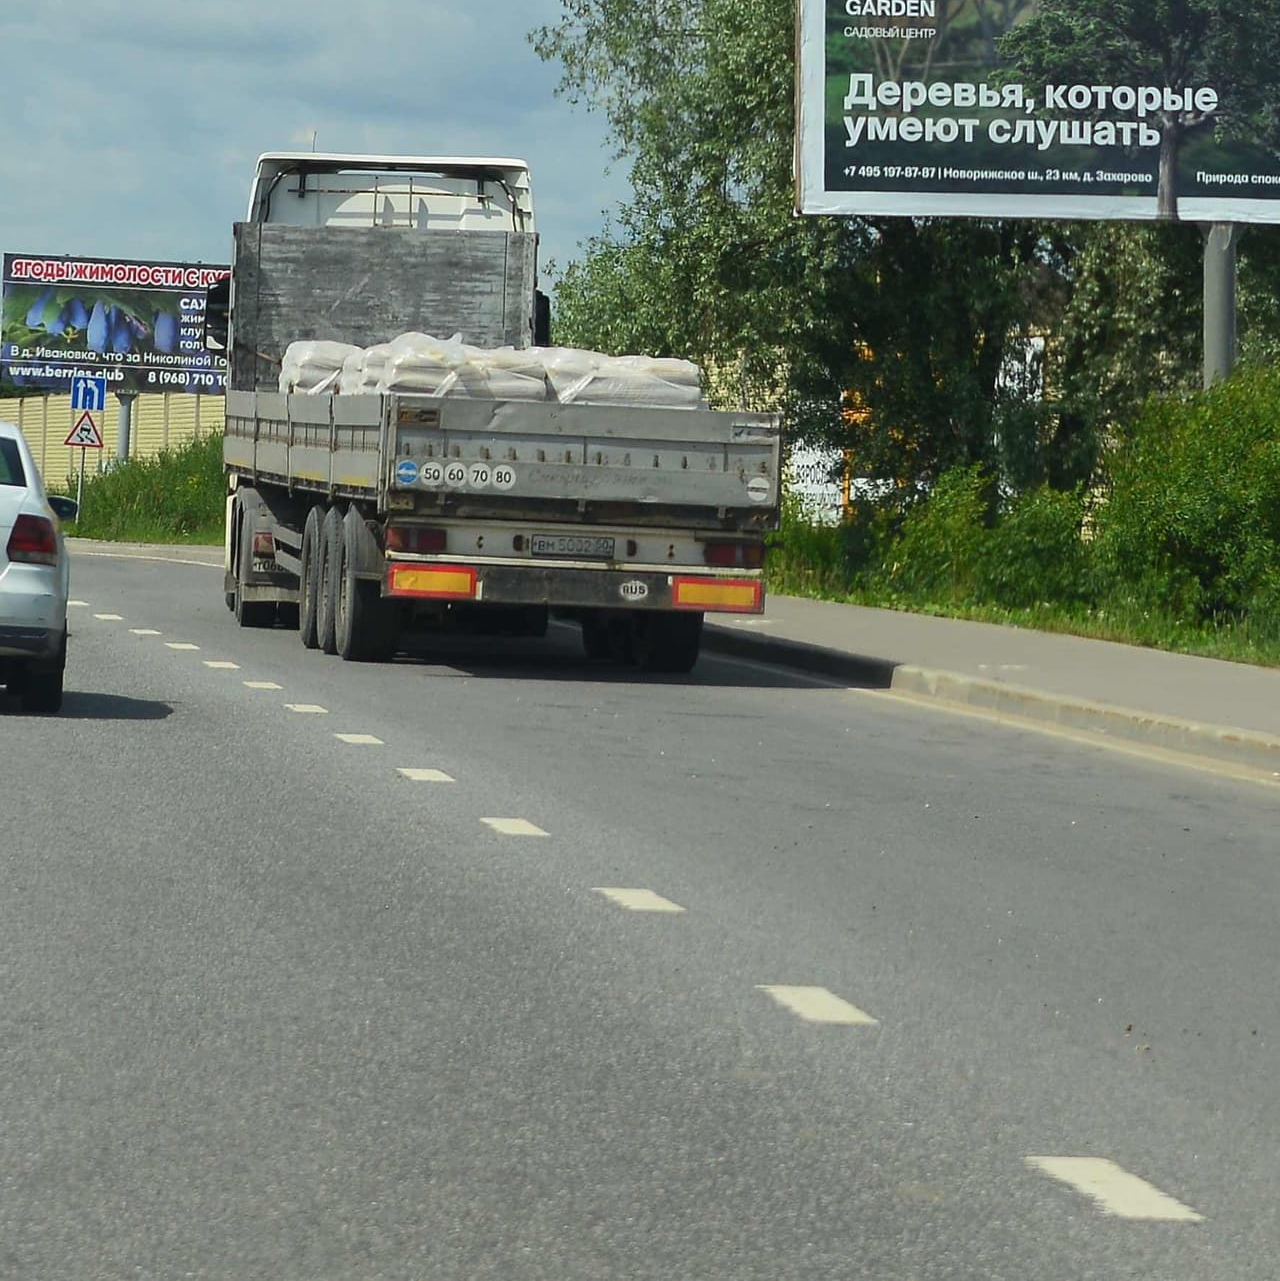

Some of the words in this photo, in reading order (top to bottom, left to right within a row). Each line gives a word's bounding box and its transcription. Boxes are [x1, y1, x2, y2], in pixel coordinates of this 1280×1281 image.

[844, 25, 899, 39] САДОВЫЙ
[901, 27, 936, 40] ЦЕНТР
[843, 73, 1035, 114] Деревья,
[1045, 84, 1218, 117] которые
[844, 115, 979, 147] умеют
[988, 118, 1161, 150] слушать
[843, 166, 855, 176] +7
[858, 165, 880, 177] 495
[883, 166, 935, 178] 197-87-87
[944, 168, 1025, 181] Новорижское
[1045, 169, 1060, 180] 23
[1096, 170, 1152, 184] Захарово
[1196, 171, 1249, 185] Природа
[11, 259, 70, 282] ЯГОДЫ
[72, 262, 183, 287] ЖИМОЛОСТИ
[184, 268, 199, 288] С
[11, 345, 20, 357] В
[35, 347, 99, 362] Ивановка,
[102, 352, 123, 363] что
[126, 353, 140, 363] за
[143, 352, 211, 367] Николиной
[9, 365, 124, 382] www.berriesclub
[148, 371, 156, 383] 8
[159, 371, 190, 386] (968)
[193, 373, 215, 386] 710
[424, 467, 440, 481] 50
[448, 468, 464, 482] 60
[472, 470, 488, 483] 70
[495, 471, 511, 484] 80
[622, 584, 646, 595] RUS
